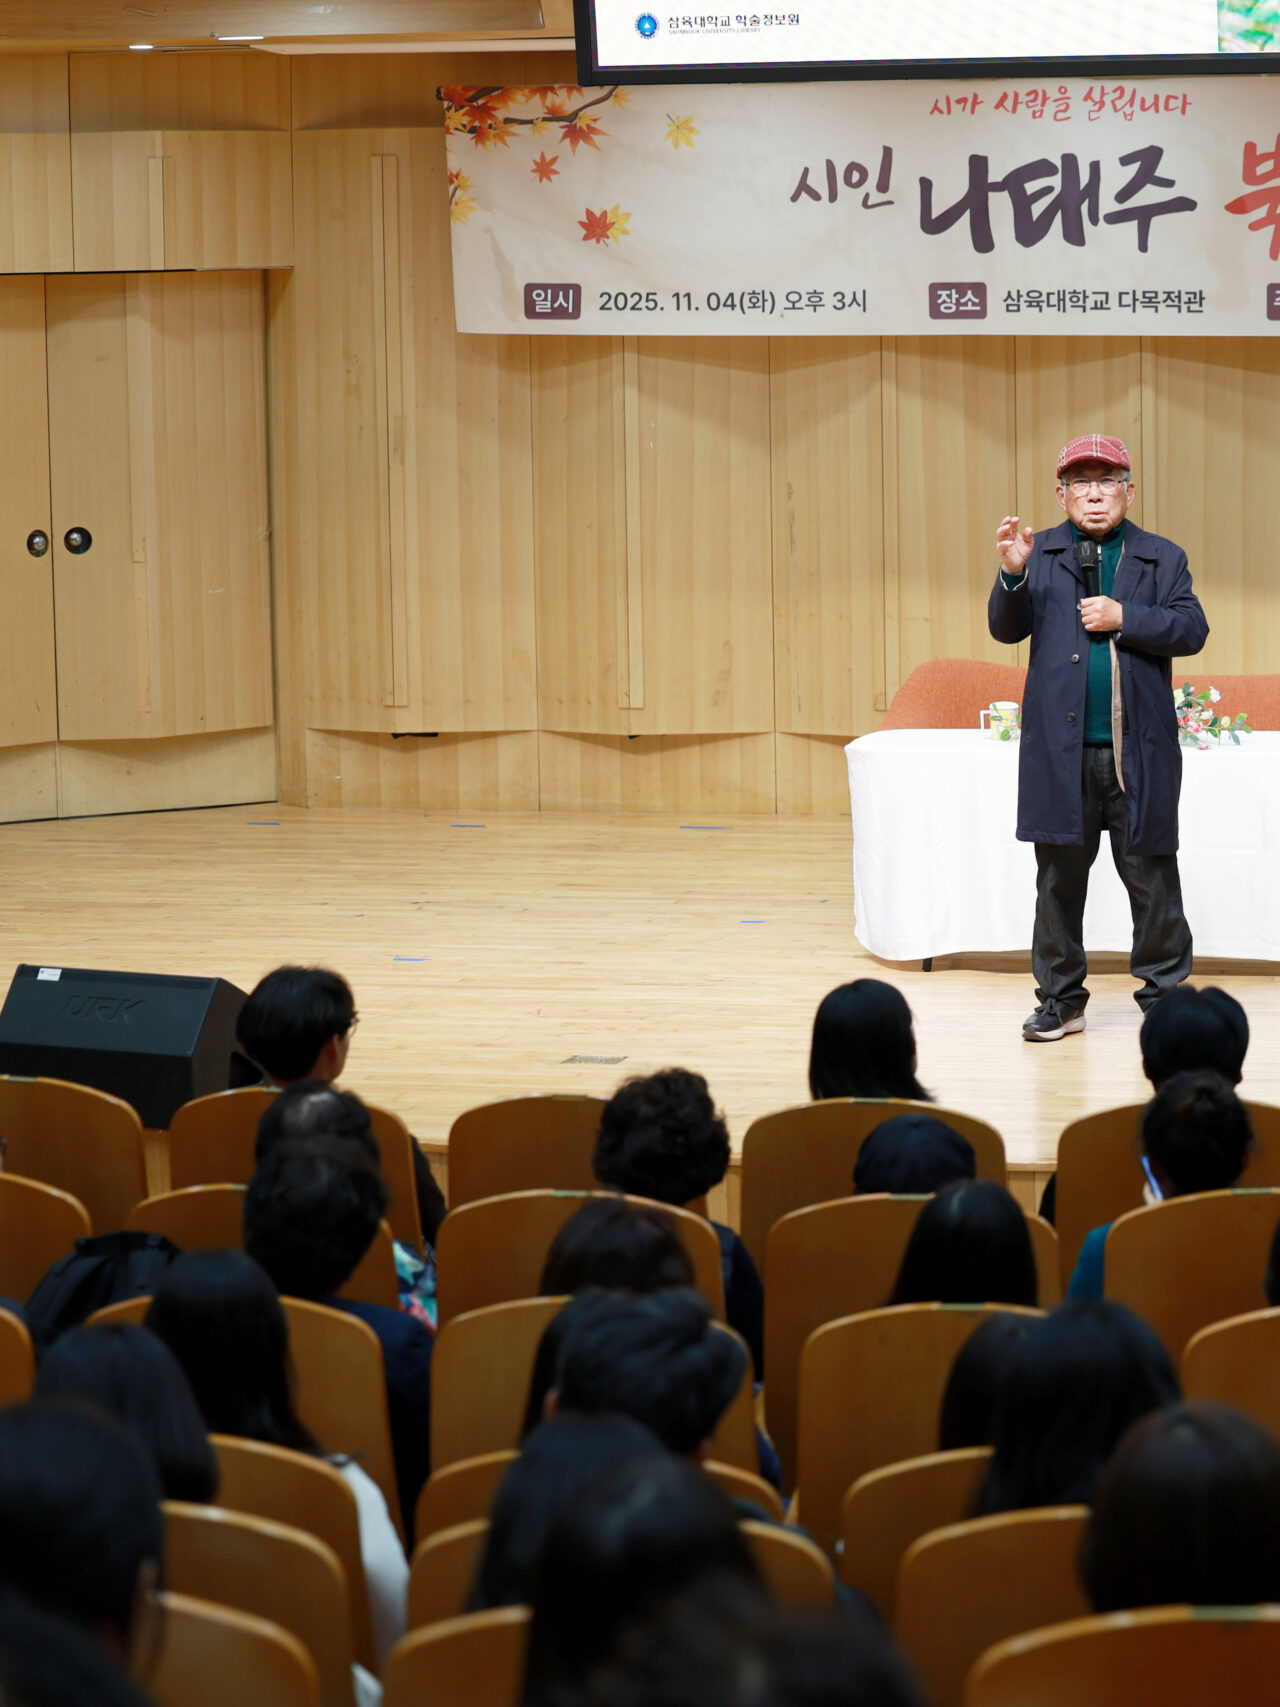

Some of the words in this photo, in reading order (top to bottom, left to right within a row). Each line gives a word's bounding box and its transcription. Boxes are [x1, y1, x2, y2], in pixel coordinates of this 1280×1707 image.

[668, 15, 731, 29] 삼육대학교
[735, 13, 800, 26] 학술정보원
[929, 91, 985, 116] 시가
[994, 86, 1072, 122] 사람을
[1082, 85, 1191, 121] 살립니다
[790, 145, 895, 210] 시인
[918, 144, 1198, 254] 나태주
[531, 289, 573, 313] 일시
[599, 291, 665, 312] 2025.
[671, 292, 700, 311] 11.
[706, 289, 776, 315] 04(화)
[783, 289, 825, 313] 오후
[832, 289, 867, 313] 3시
[937, 289, 981, 313] 장소
[1002, 289, 1111, 314] 삼육대학교
[1118, 289, 1206, 314] 다목적관
